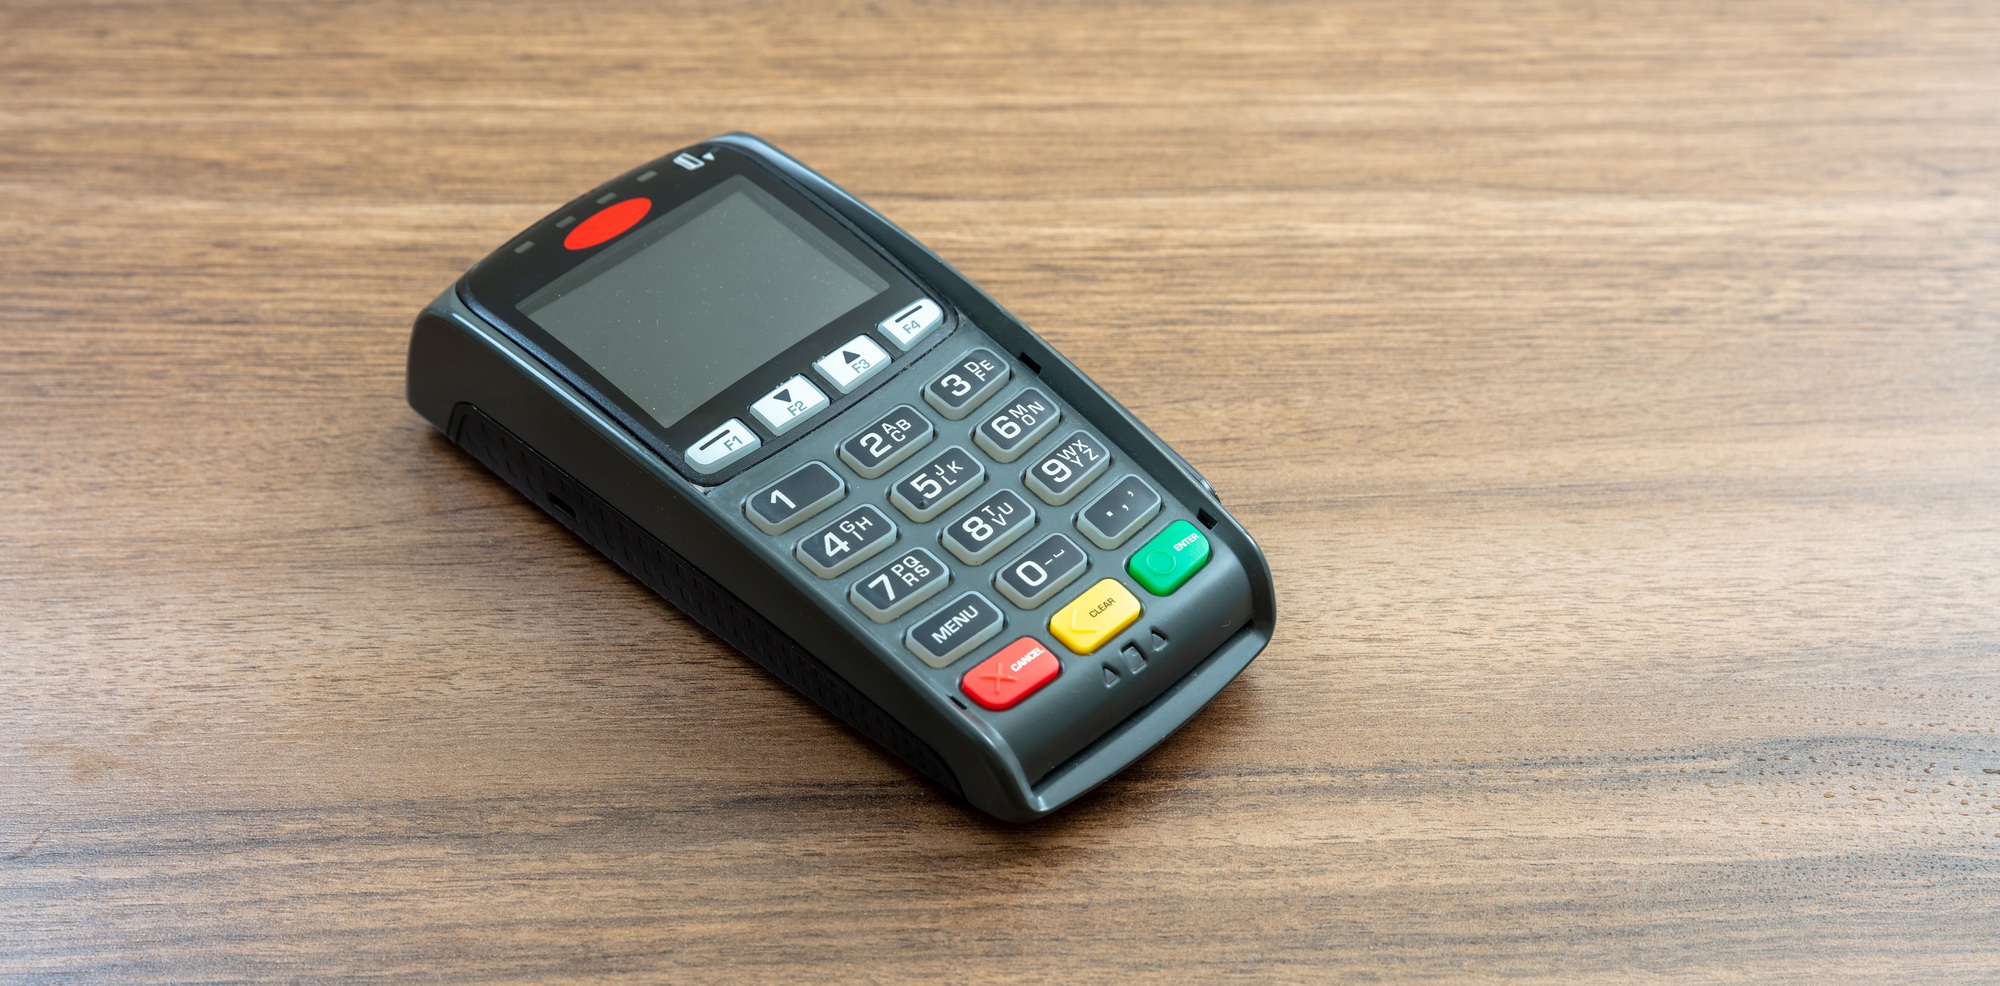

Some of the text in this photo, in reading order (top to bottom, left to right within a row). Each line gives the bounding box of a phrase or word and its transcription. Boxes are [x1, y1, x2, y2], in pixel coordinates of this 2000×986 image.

[902, 319, 921, 334] F4
[851, 358, 871, 374] F3
[940, 373, 972, 397] 3
[786, 400, 808, 417] F2
[991, 415, 1022, 439] 6
[723, 435, 743, 452] F1
[859, 432, 893, 458] 2
[1041, 458, 1072, 483] 9
[909, 472, 943, 499] 5
[770, 489, 797, 509] 1
[961, 516, 994, 542] 8
[823, 531, 851, 557] 4
[1173, 533, 1201, 552] ENTER
[867, 573, 896, 601] 7
[1088, 597, 1116, 618] CLEAR
[931, 605, 979, 644] MENU
[1010, 647, 1046, 672] CANCEL
